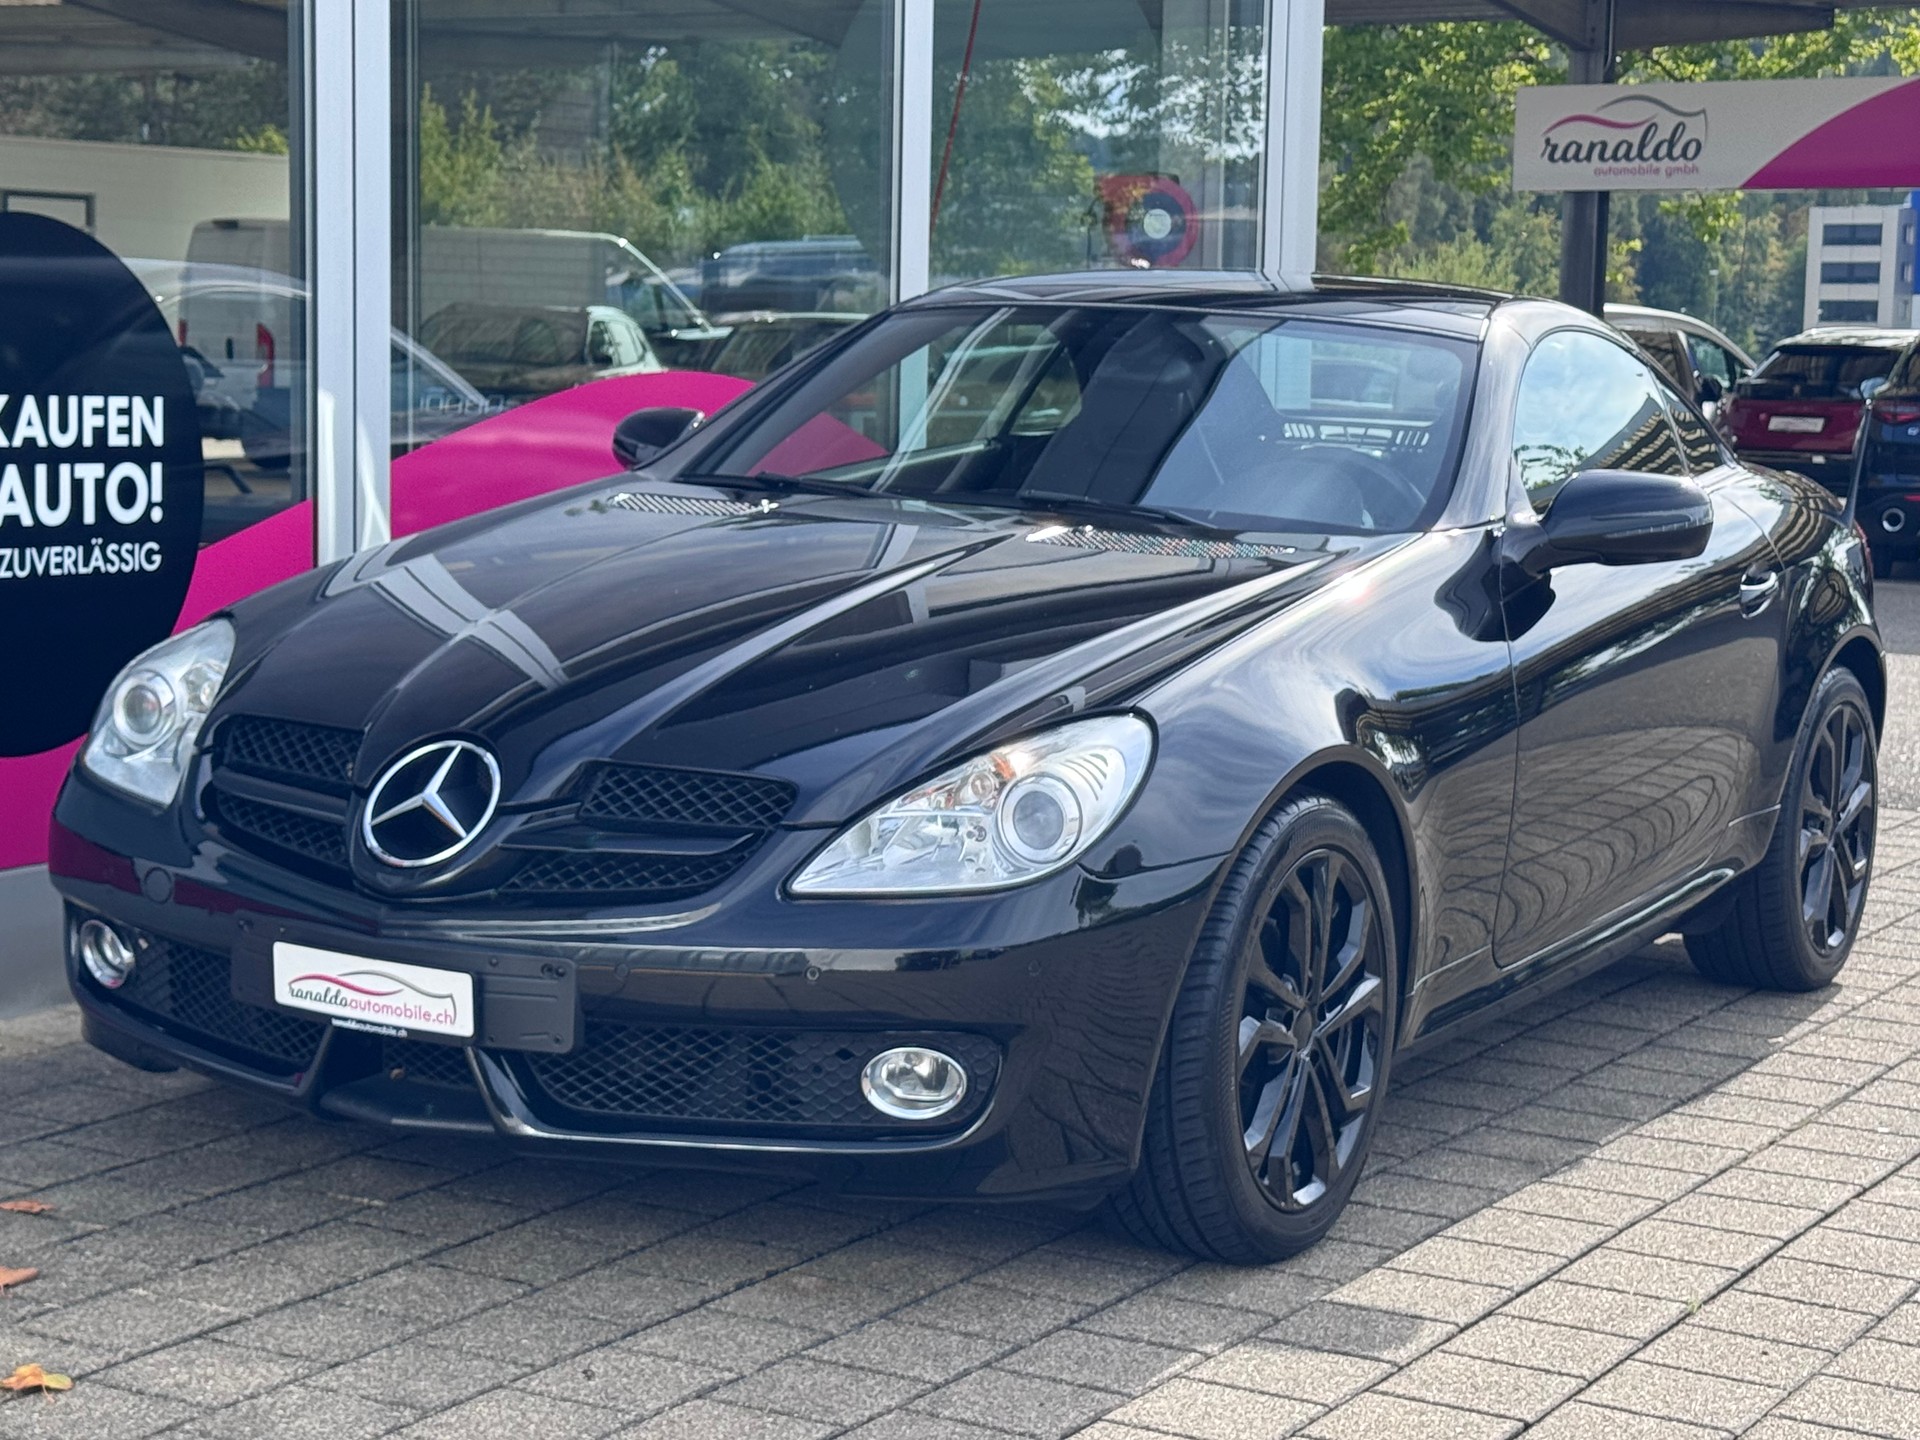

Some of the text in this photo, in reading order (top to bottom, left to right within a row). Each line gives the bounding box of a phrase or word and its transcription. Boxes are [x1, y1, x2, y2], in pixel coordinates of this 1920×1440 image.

[1540, 121, 1703, 163] ranaldo
[1593, 163, 1700, 178] automobile gmbh
[0, 461, 164, 527] AUTO!
[0, 537, 163, 579] ZUVERLÄSSIG
